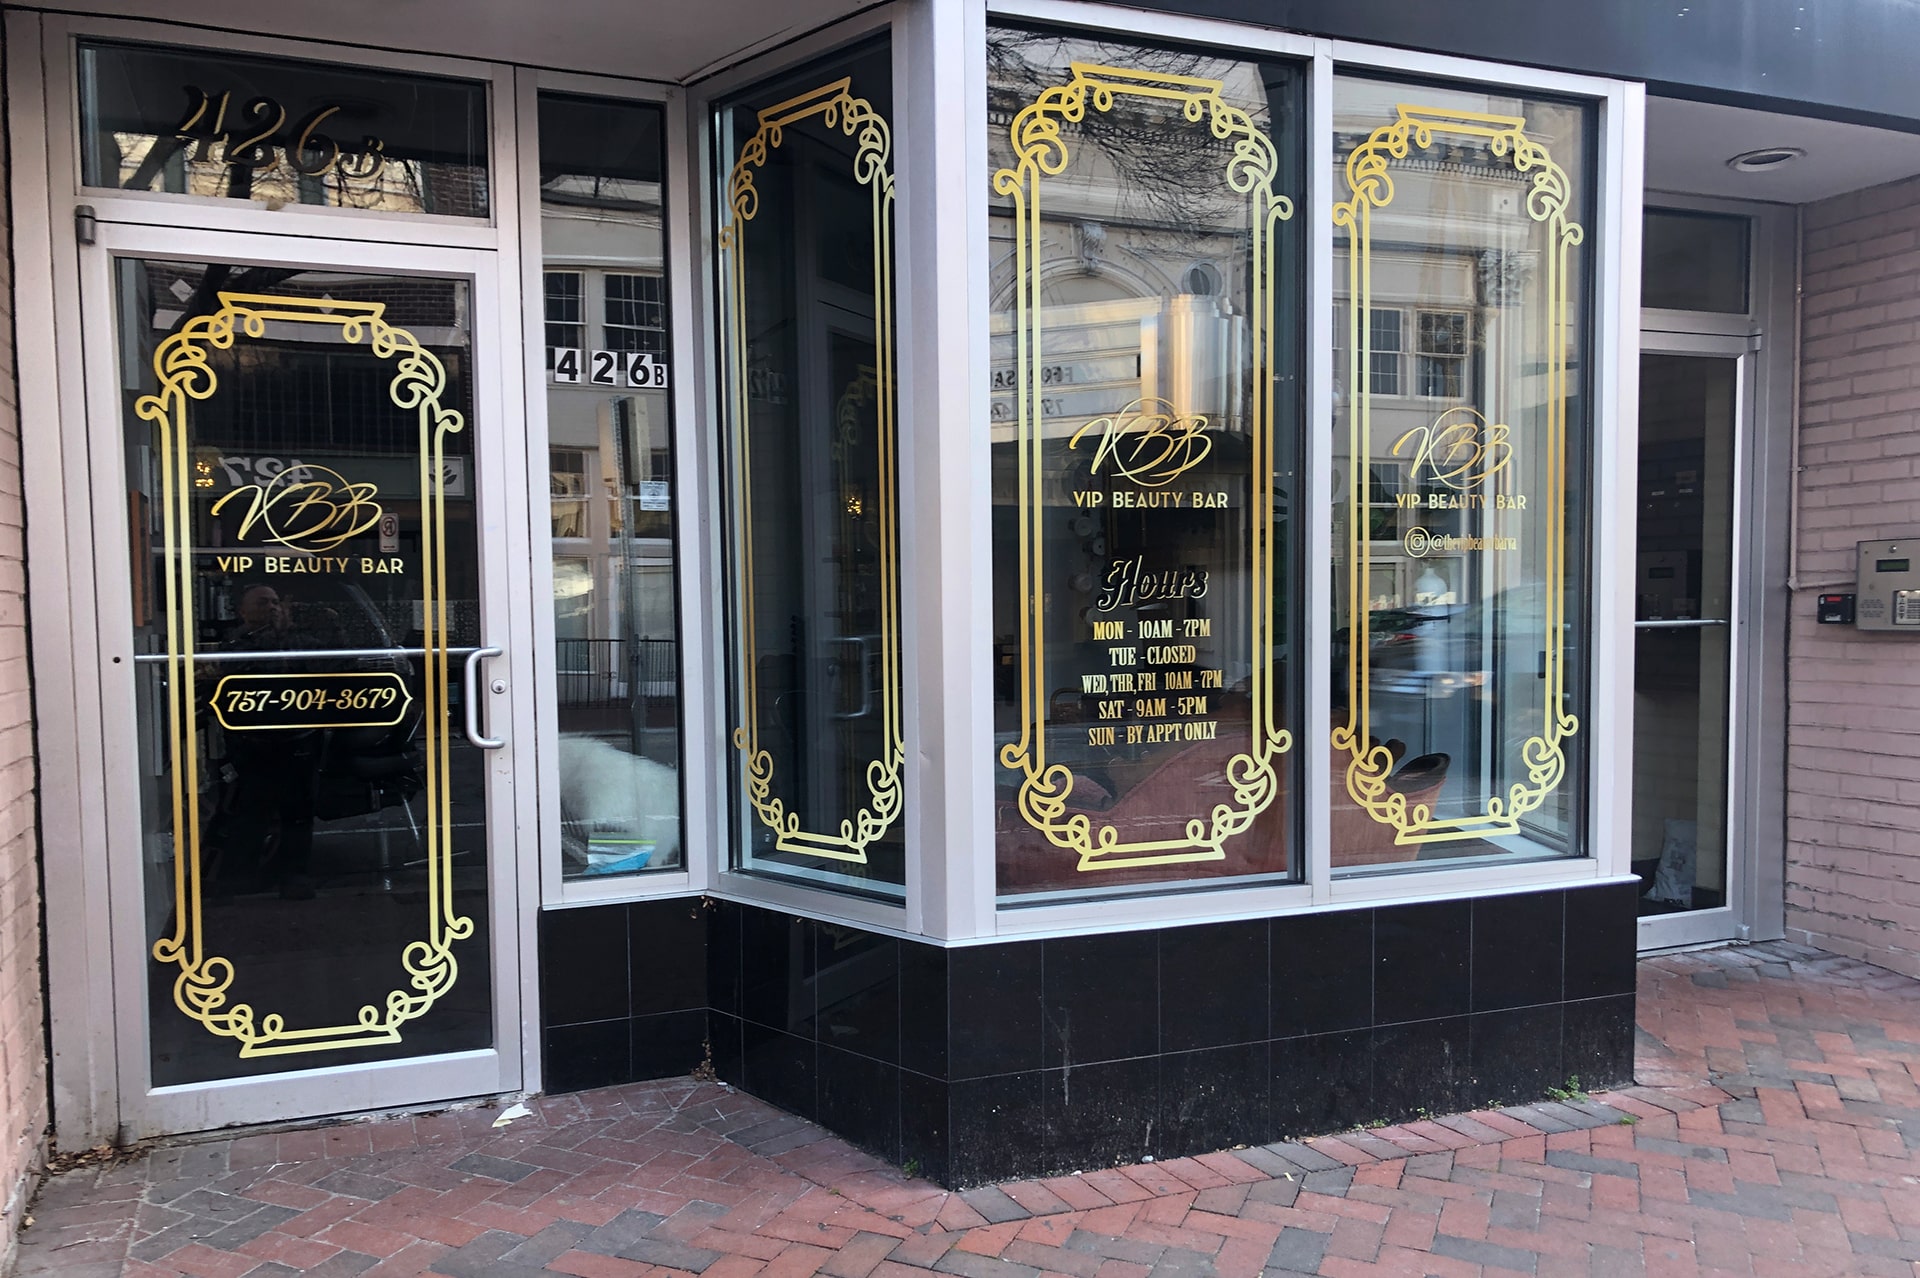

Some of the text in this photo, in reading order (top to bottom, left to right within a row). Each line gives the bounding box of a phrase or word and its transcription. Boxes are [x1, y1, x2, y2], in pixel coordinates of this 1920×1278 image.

[1073, 491, 1228, 509] VIP BEAUTY BAR
[1395, 493, 1527, 510] VIP BEAUTY BAR
[217, 556, 404, 574] VIP BEAUTY BAR
[1096, 555, 1209, 612] Hours
[1093, 620, 1124, 641] MON
[1138, 619, 1173, 639] 10AM
[1183, 618, 1211, 638] 7PM
[1109, 646, 1136, 667] TUE
[1165, 671, 1192, 690] 10AM
[1200, 669, 1223, 689] 7PM
[226, 687, 397, 713] 757-904-3679
[1098, 700, 1125, 719] SAT
[1135, 698, 1167, 718] 9AM
[1177, 696, 1207, 715] 5PM
[1088, 726, 1115, 746] SUN
[1127, 725, 1144, 744] BY
[1147, 723, 1182, 743] APPT
[1184, 721, 1218, 741] ONLY
